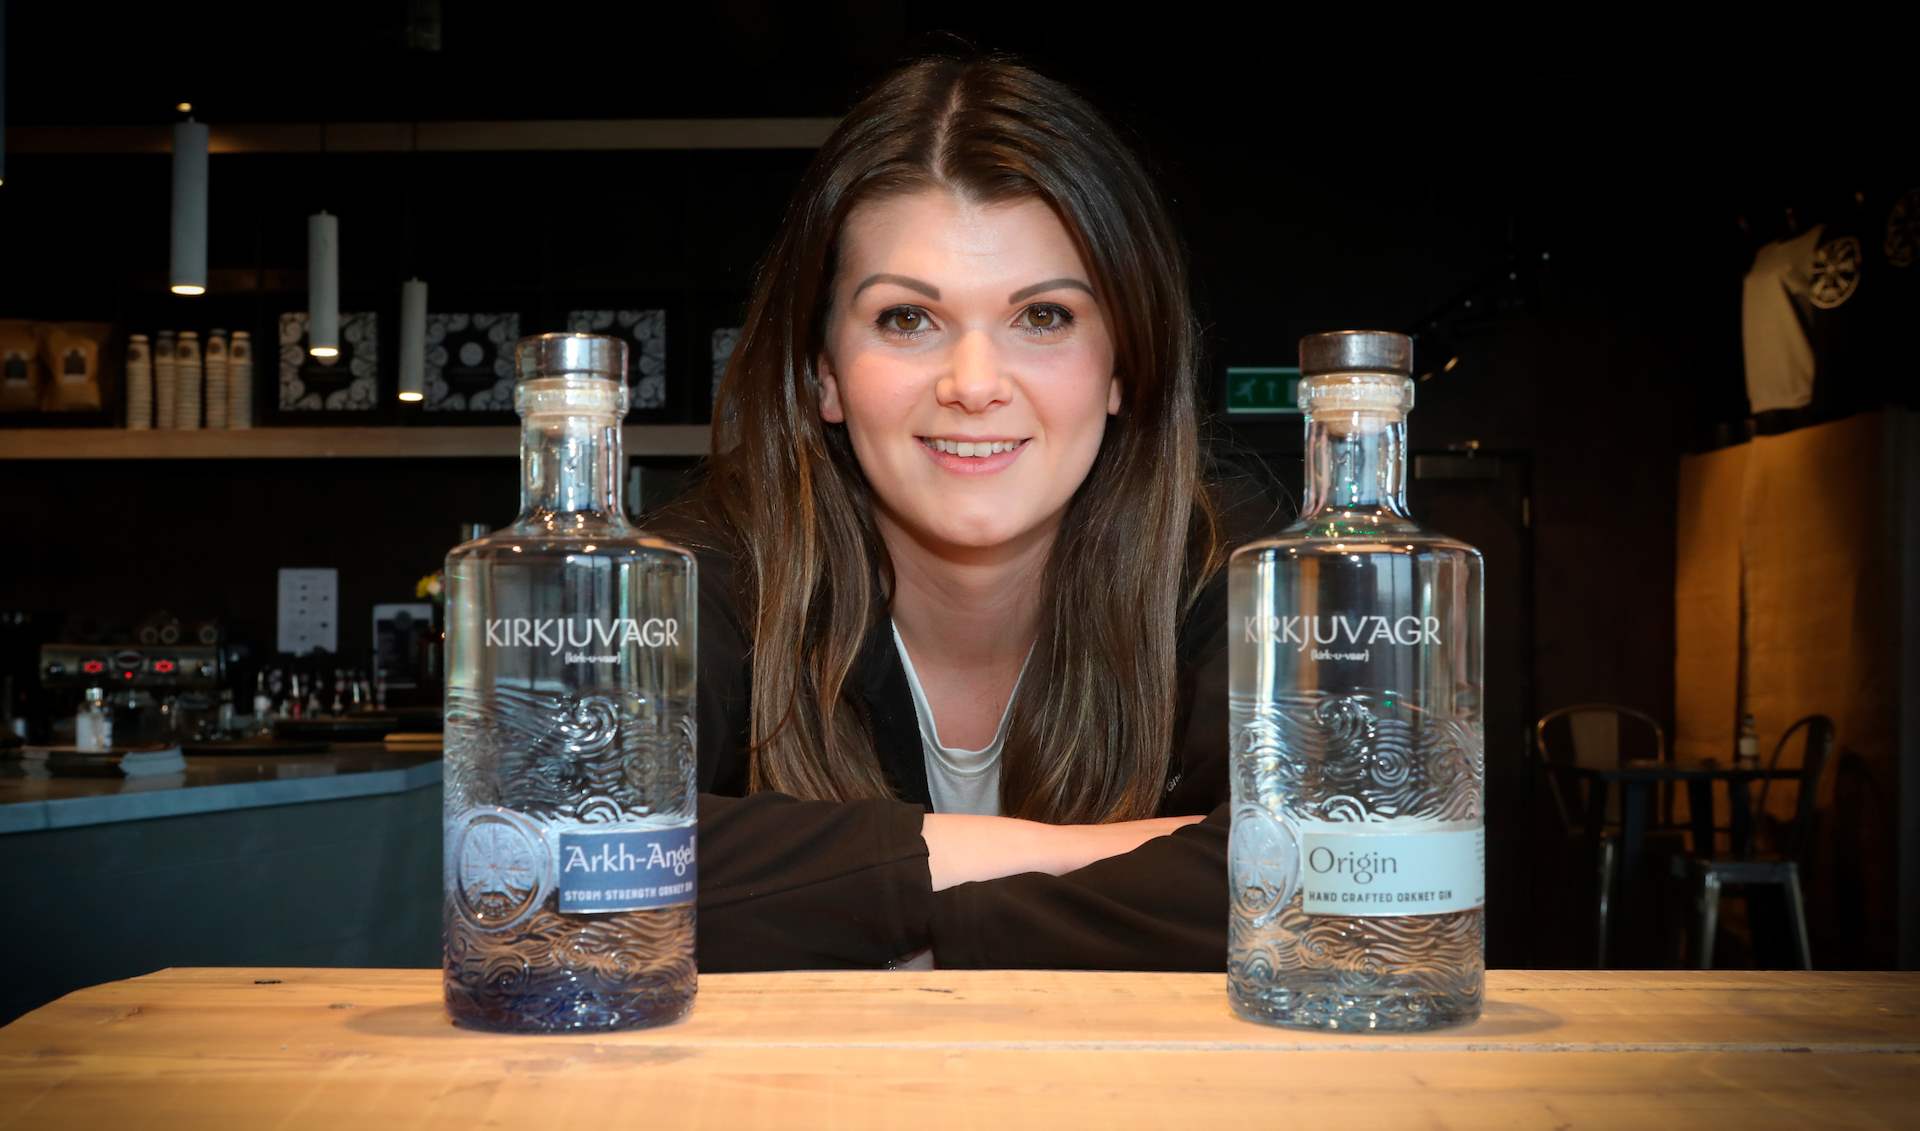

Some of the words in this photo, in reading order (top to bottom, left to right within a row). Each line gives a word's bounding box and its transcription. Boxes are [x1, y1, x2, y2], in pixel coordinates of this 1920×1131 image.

[486, 618, 679, 656] KIRKJUVAGR
[1309, 846, 1397, 885] Origin
[564, 890, 602, 902] STORM
[605, 887, 657, 901] STRENGTH
[1309, 891, 1337, 903] HAND
[1341, 891, 1393, 903] CRAFTED
[1397, 891, 1435, 903] ORKNEY
[1439, 890, 1453, 900] GIN
